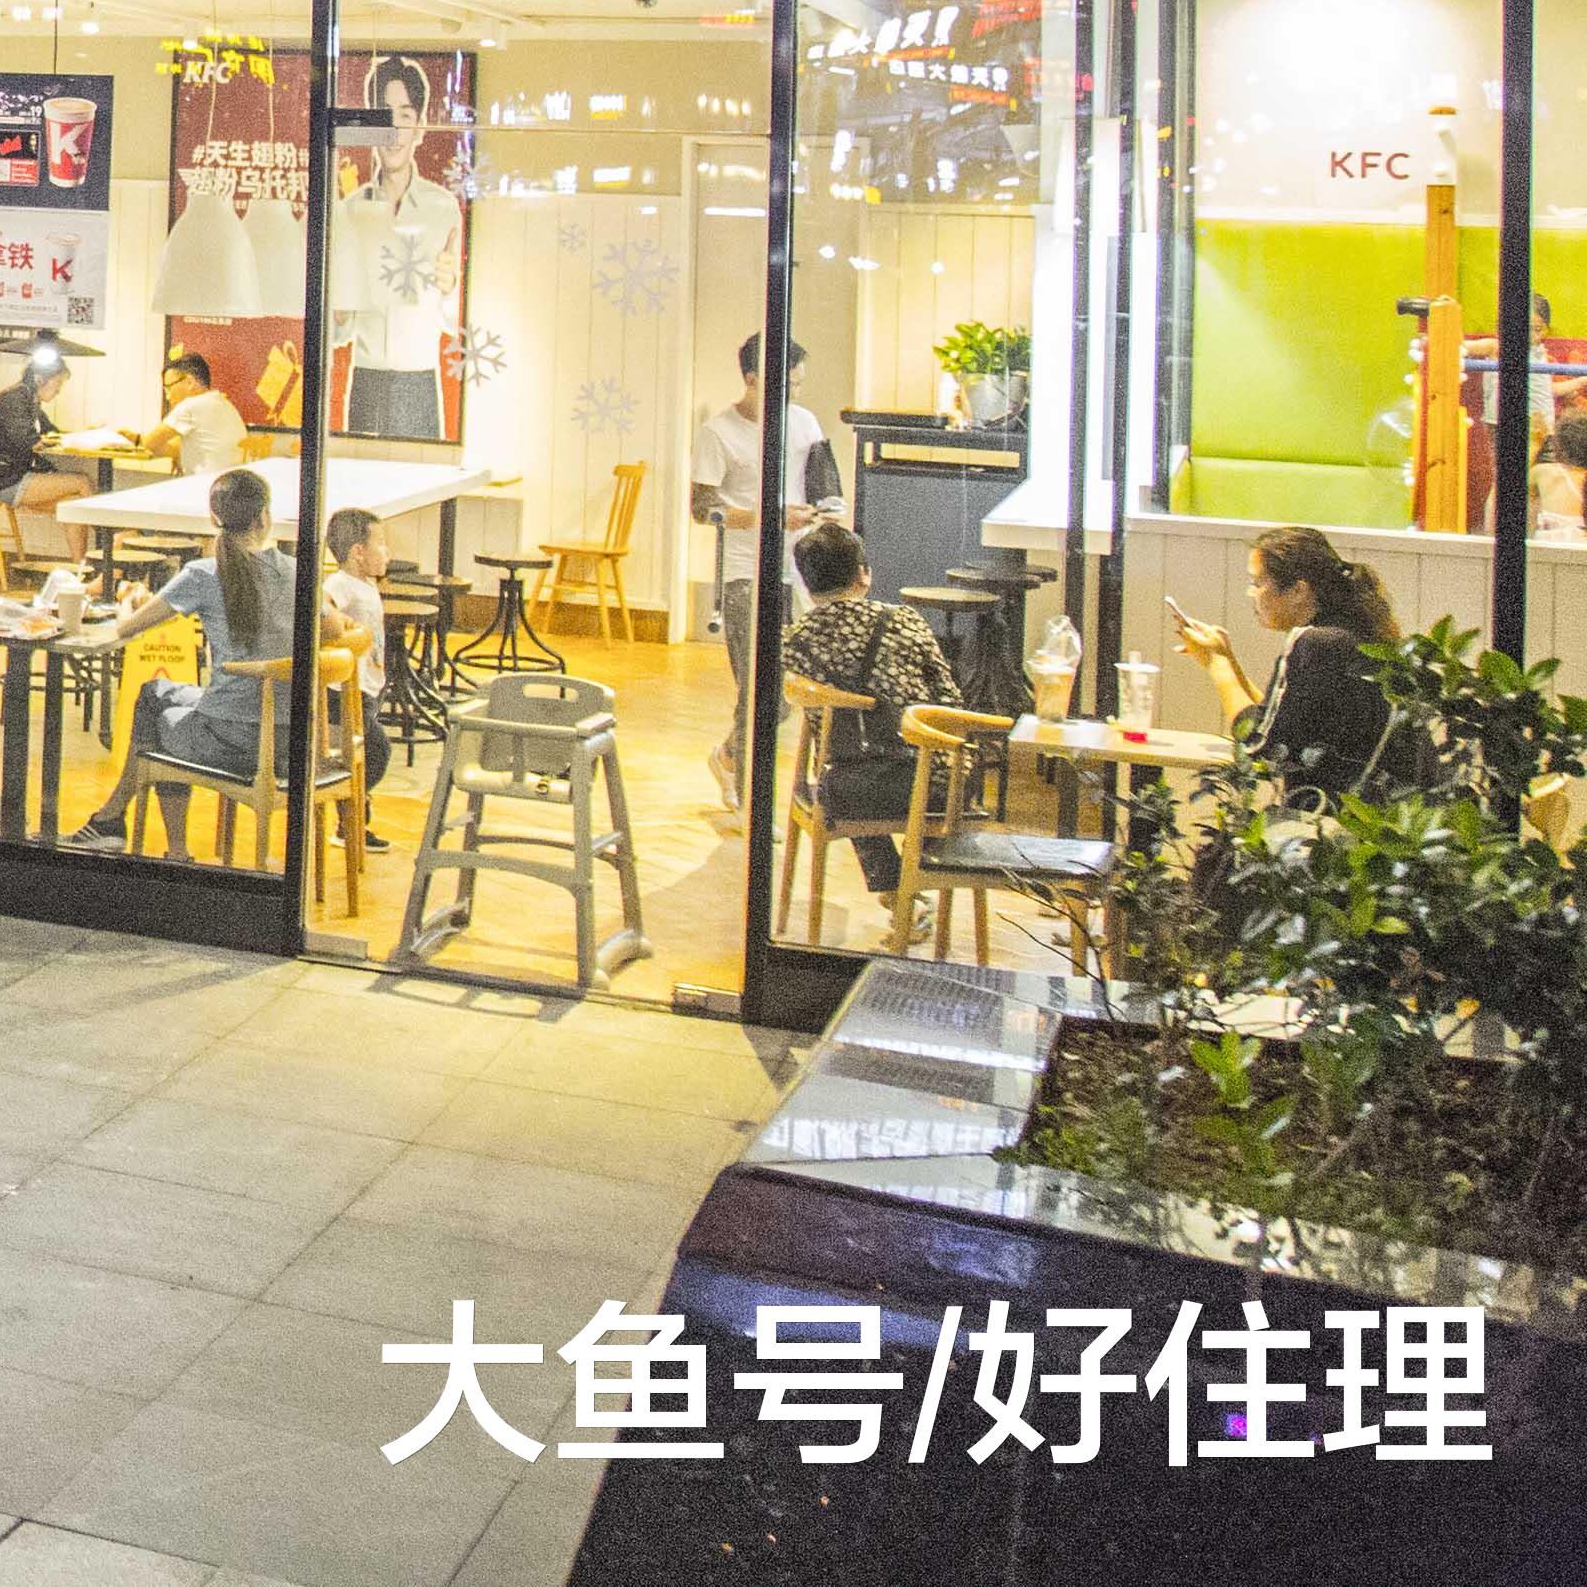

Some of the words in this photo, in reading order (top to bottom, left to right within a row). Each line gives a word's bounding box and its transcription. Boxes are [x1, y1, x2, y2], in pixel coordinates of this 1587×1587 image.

[183, 61, 230, 83] KFC
[1330, 151, 1411, 181] KFC
[143, 644, 181, 653] CAUTION
[139, 654, 156, 663] WET
